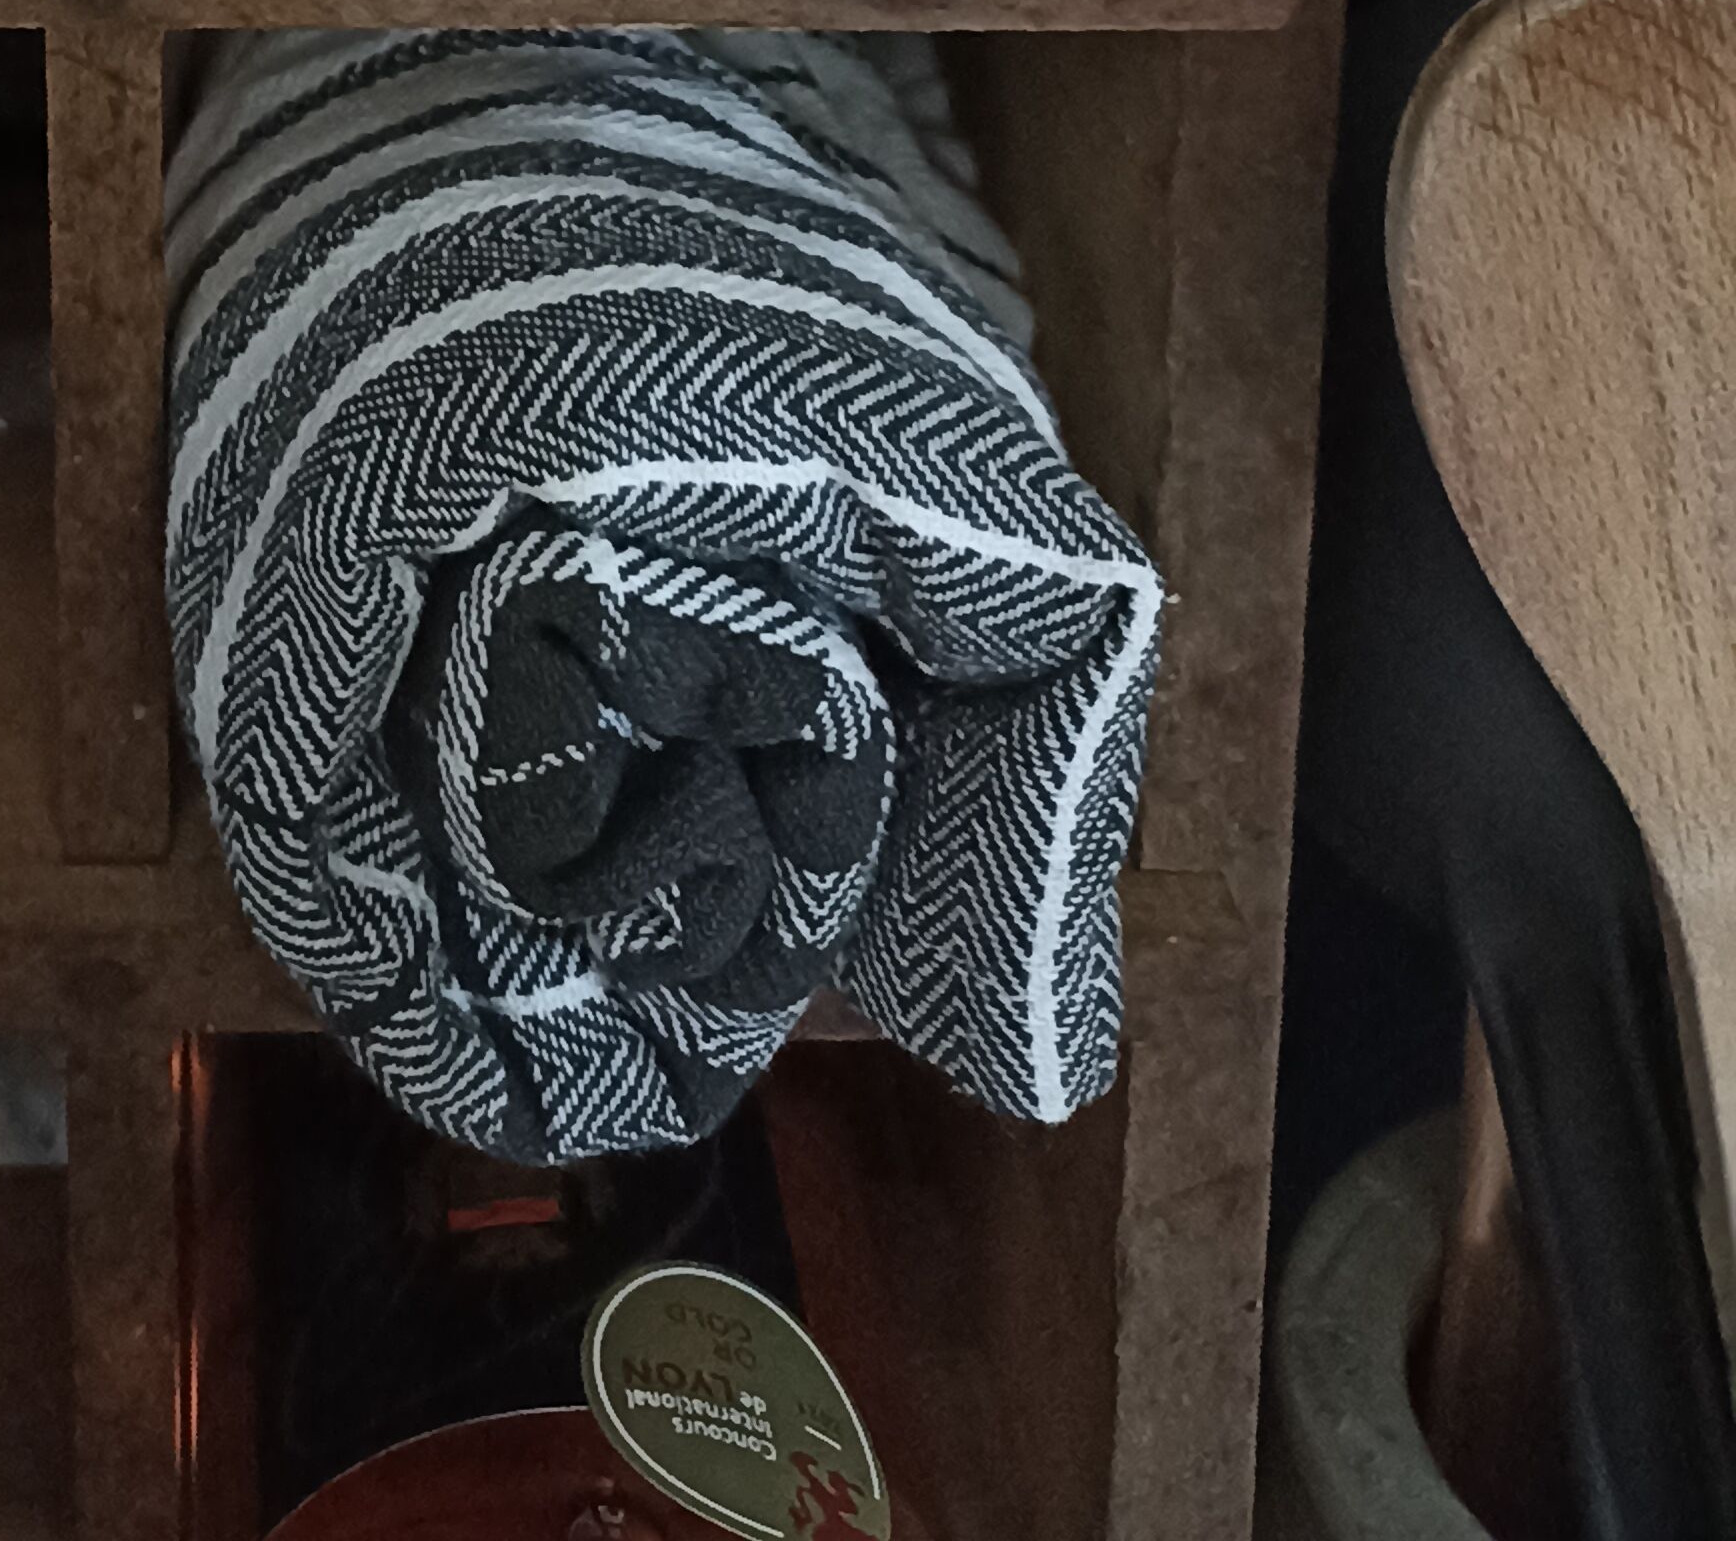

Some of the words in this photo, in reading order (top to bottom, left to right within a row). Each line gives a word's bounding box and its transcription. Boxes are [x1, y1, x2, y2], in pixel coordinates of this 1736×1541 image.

[714, 1340, 756, 1370] OR
[622, 1357, 733, 1402] LYON
[740, 1391, 766, 1416] de
[672, 1417, 776, 1461] Concours
